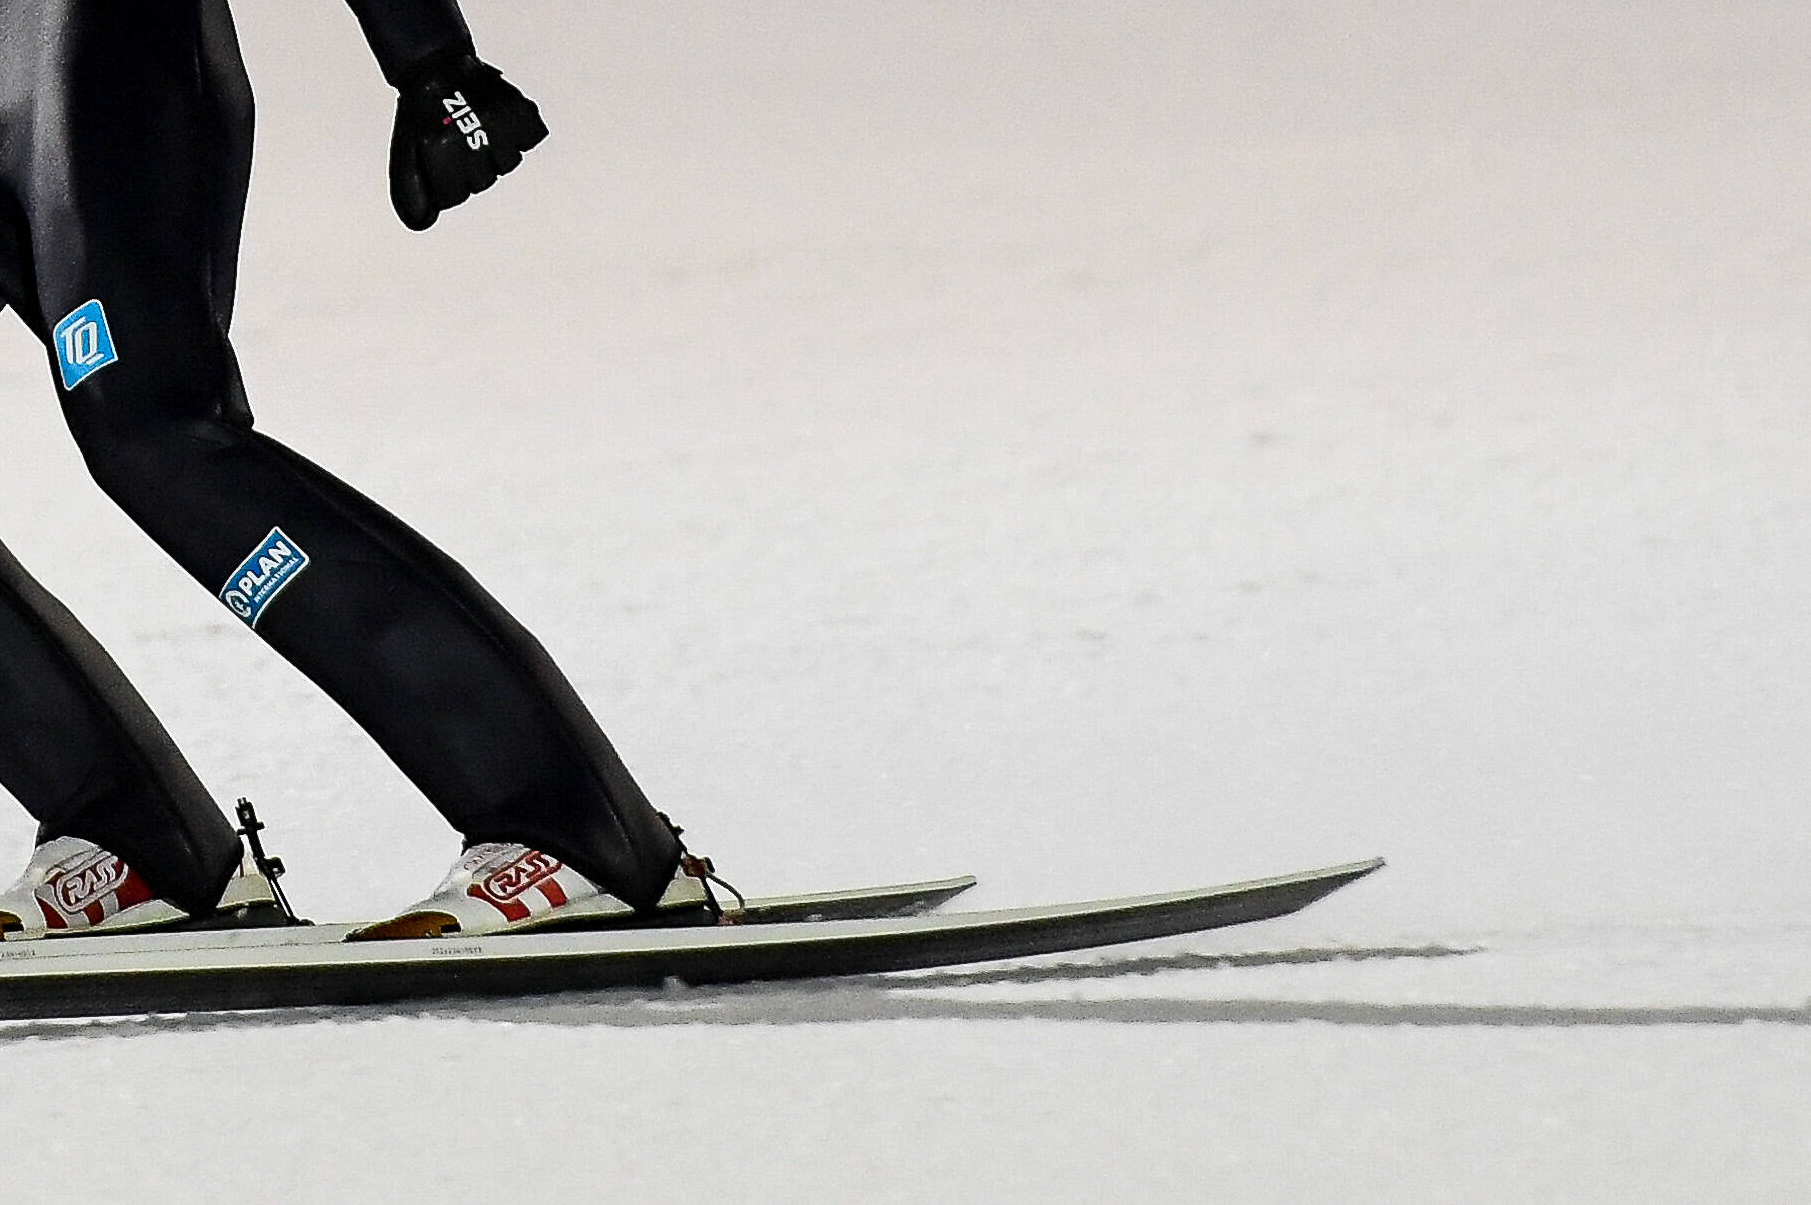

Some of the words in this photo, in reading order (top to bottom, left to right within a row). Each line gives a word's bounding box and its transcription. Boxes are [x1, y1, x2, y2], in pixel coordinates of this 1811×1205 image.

[442, 90, 489, 150] SEIZ
[60, 316, 105, 365] TQ
[238, 540, 292, 597] PLAN
